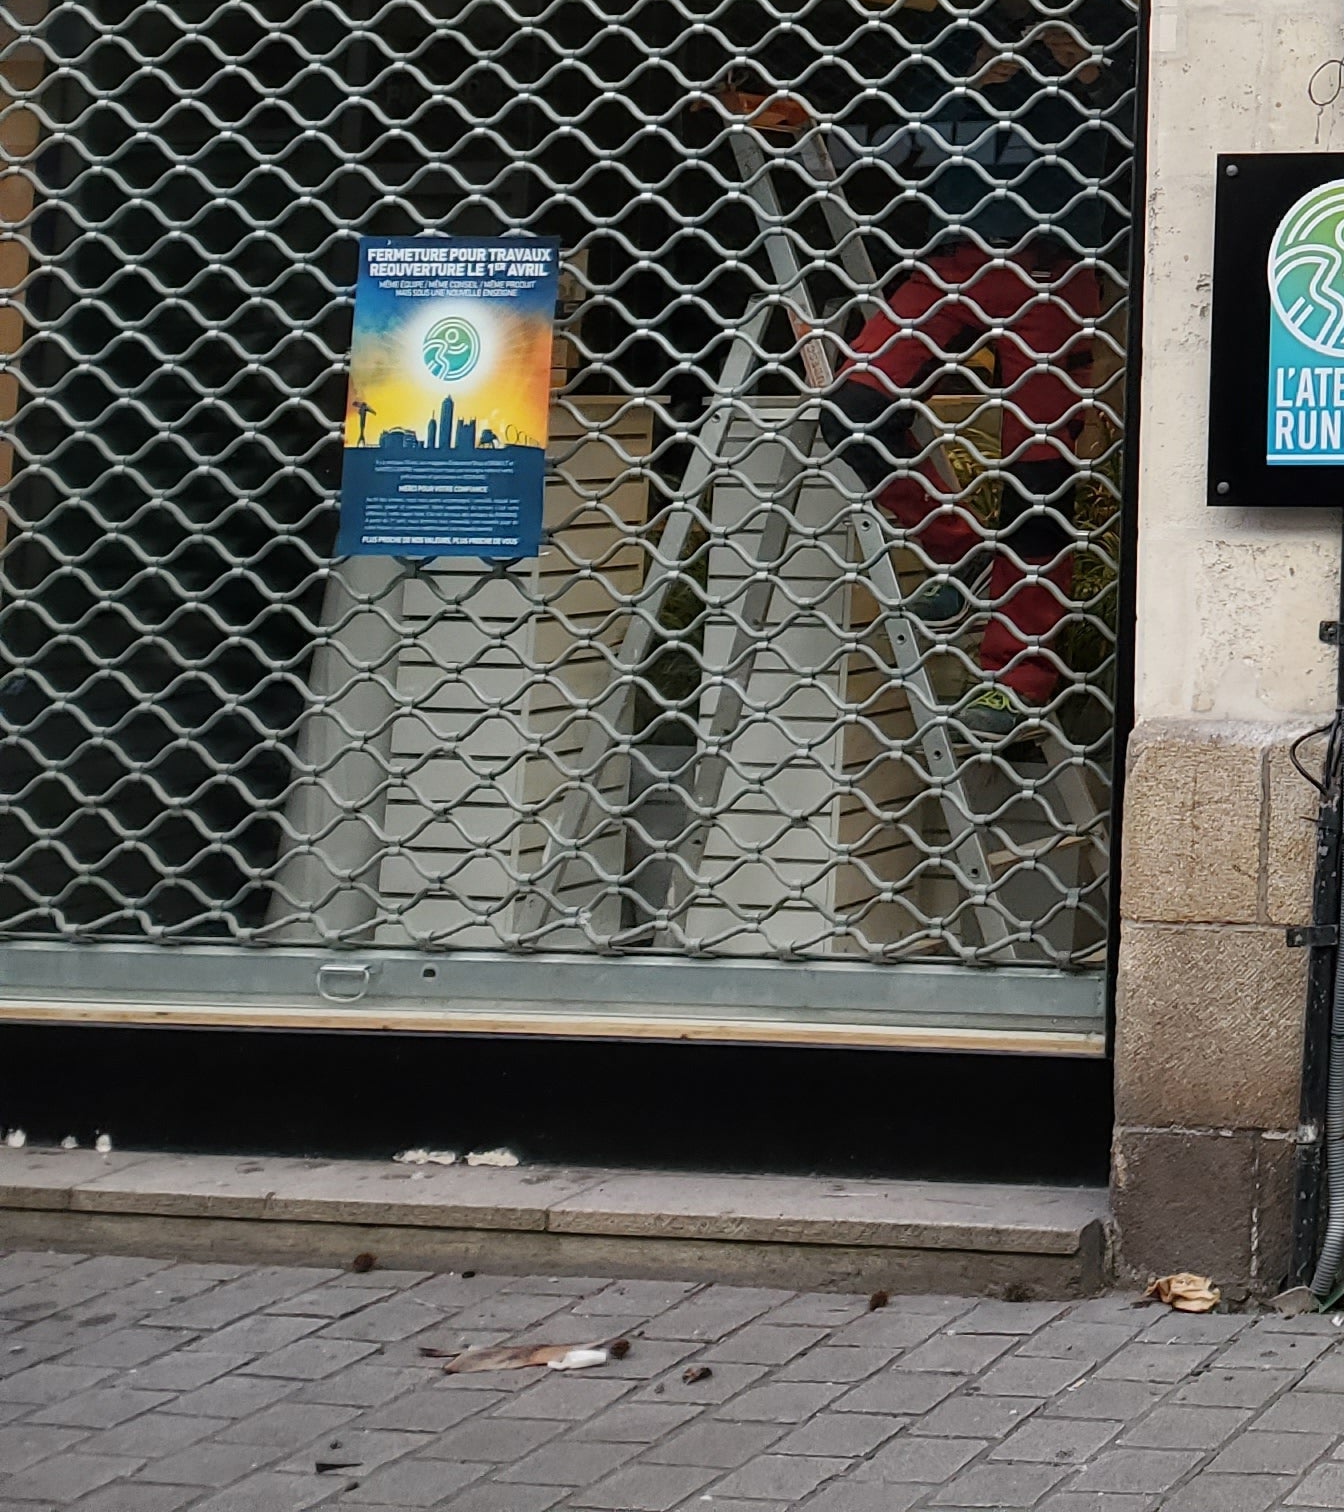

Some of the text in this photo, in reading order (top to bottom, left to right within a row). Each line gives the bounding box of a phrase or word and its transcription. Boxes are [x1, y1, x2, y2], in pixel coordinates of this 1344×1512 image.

[367, 249, 552, 261] FERMETURE POUR TRAVAUX
[370, 263, 466, 276] REOUVERTURE
[467, 263, 485, 276] LE
[507, 263, 549, 276] AVRIL
